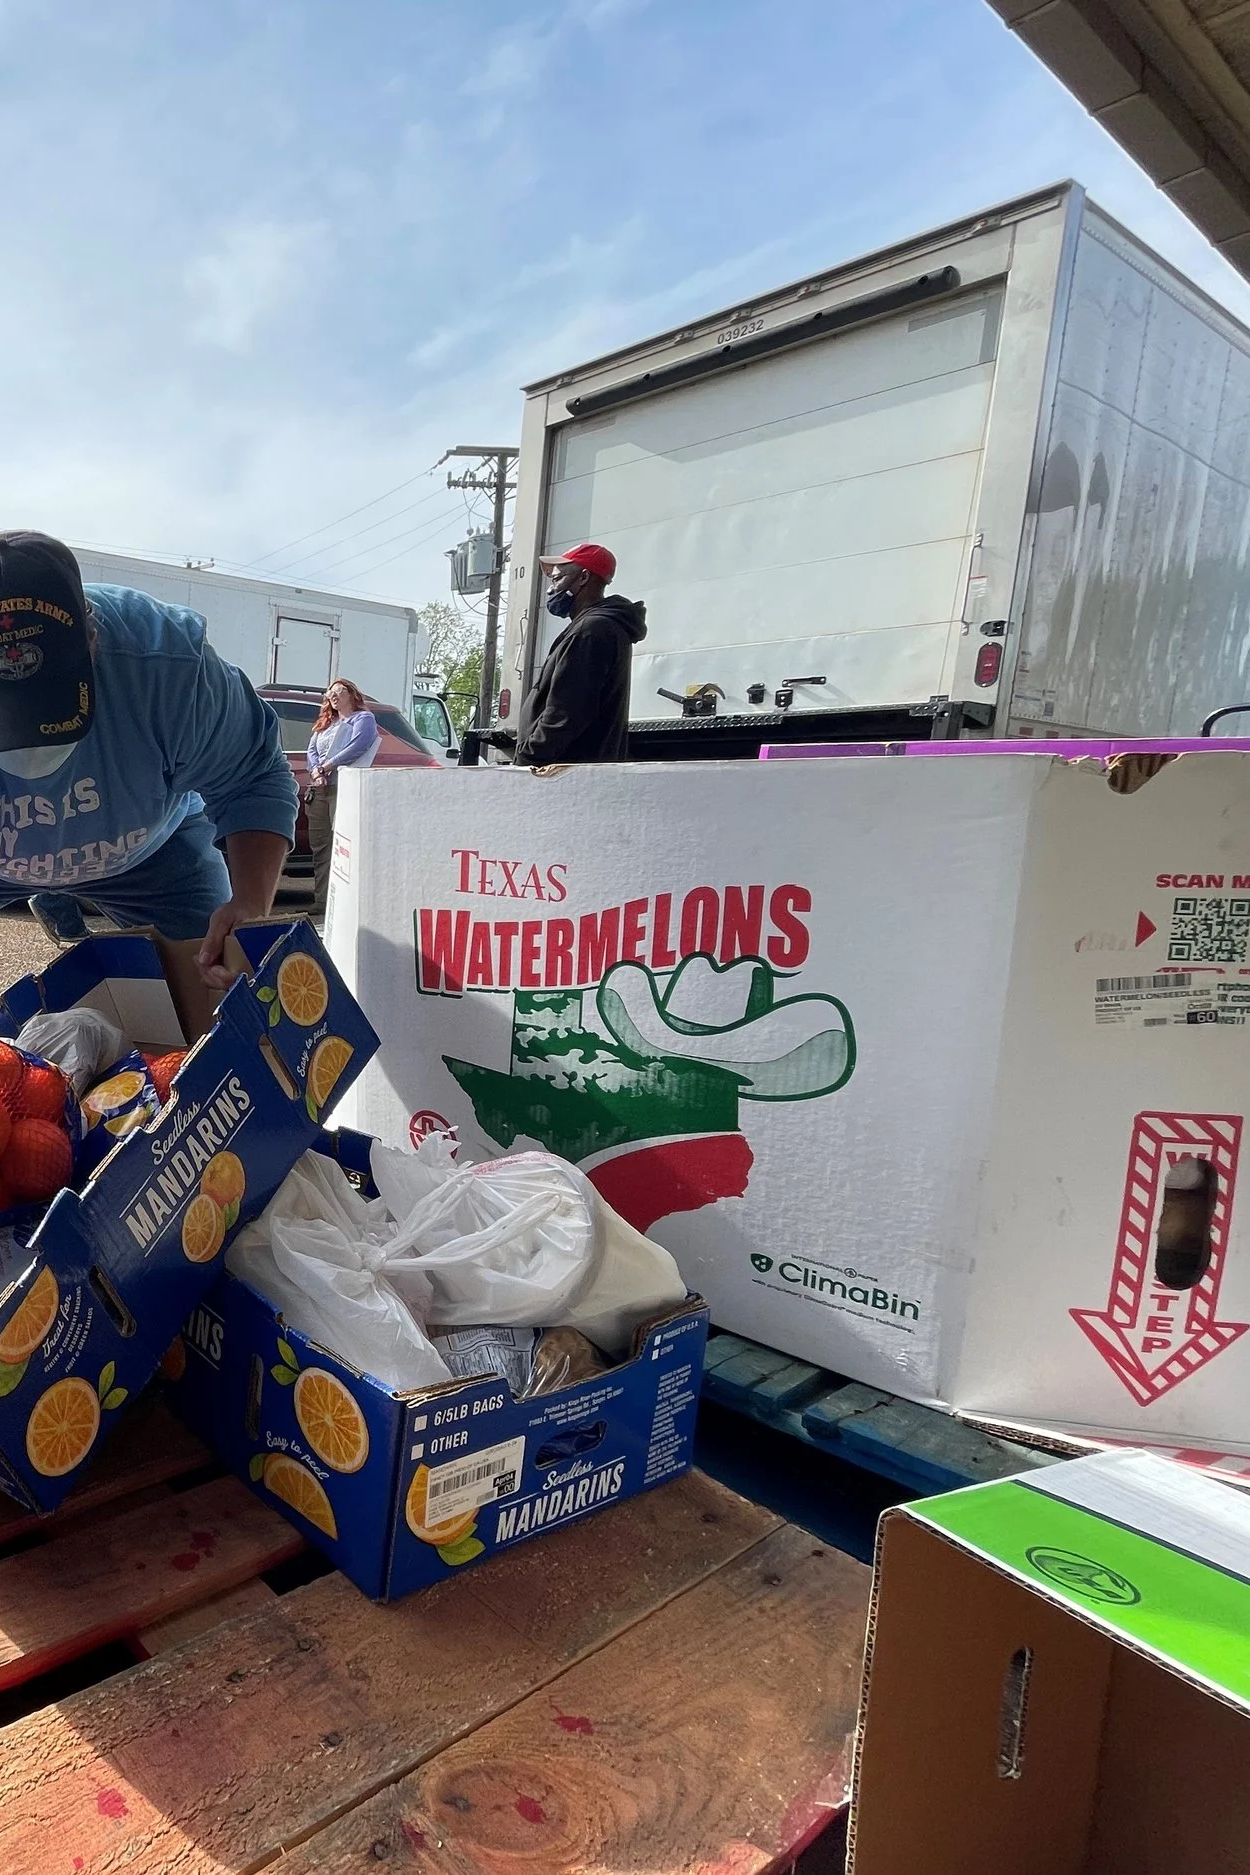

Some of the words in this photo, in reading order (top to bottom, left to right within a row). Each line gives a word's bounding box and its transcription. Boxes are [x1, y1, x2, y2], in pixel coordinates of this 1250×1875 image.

[717, 318, 765, 345] 039232
[513, 566, 526, 580] 10
[14, 624, 44, 641] MEDIC
[34, 599, 72, 625] ARMY
[39, 714, 84, 735] COMBAT
[78, 681, 89, 716] MEDIC
[62, 777, 100, 822] IS
[451, 849, 568, 902] TEXAS
[1155, 873, 1226, 889] SCAN
[415, 884, 813, 997] WATERMELONS
[296, 1050, 310, 1078] Easy
[305, 1038, 313, 1050] to
[313, 1021, 328, 1044] peel
[152, 1101, 201, 1166] Seedless
[124, 1075, 252, 1249] MANDARINS
[433, 1404, 468, 1426] 6/5LB
[472, 1394, 504, 1416] BAGS
[266, 1431, 290, 1451] Easy
[290, 1439, 302, 1454] to
[301, 1453, 330, 1481] peel
[430, 1430, 469, 1454] OTHER
[542, 1458, 595, 1492] Seedless
[495, 1467, 625, 1545] MANDARINS
